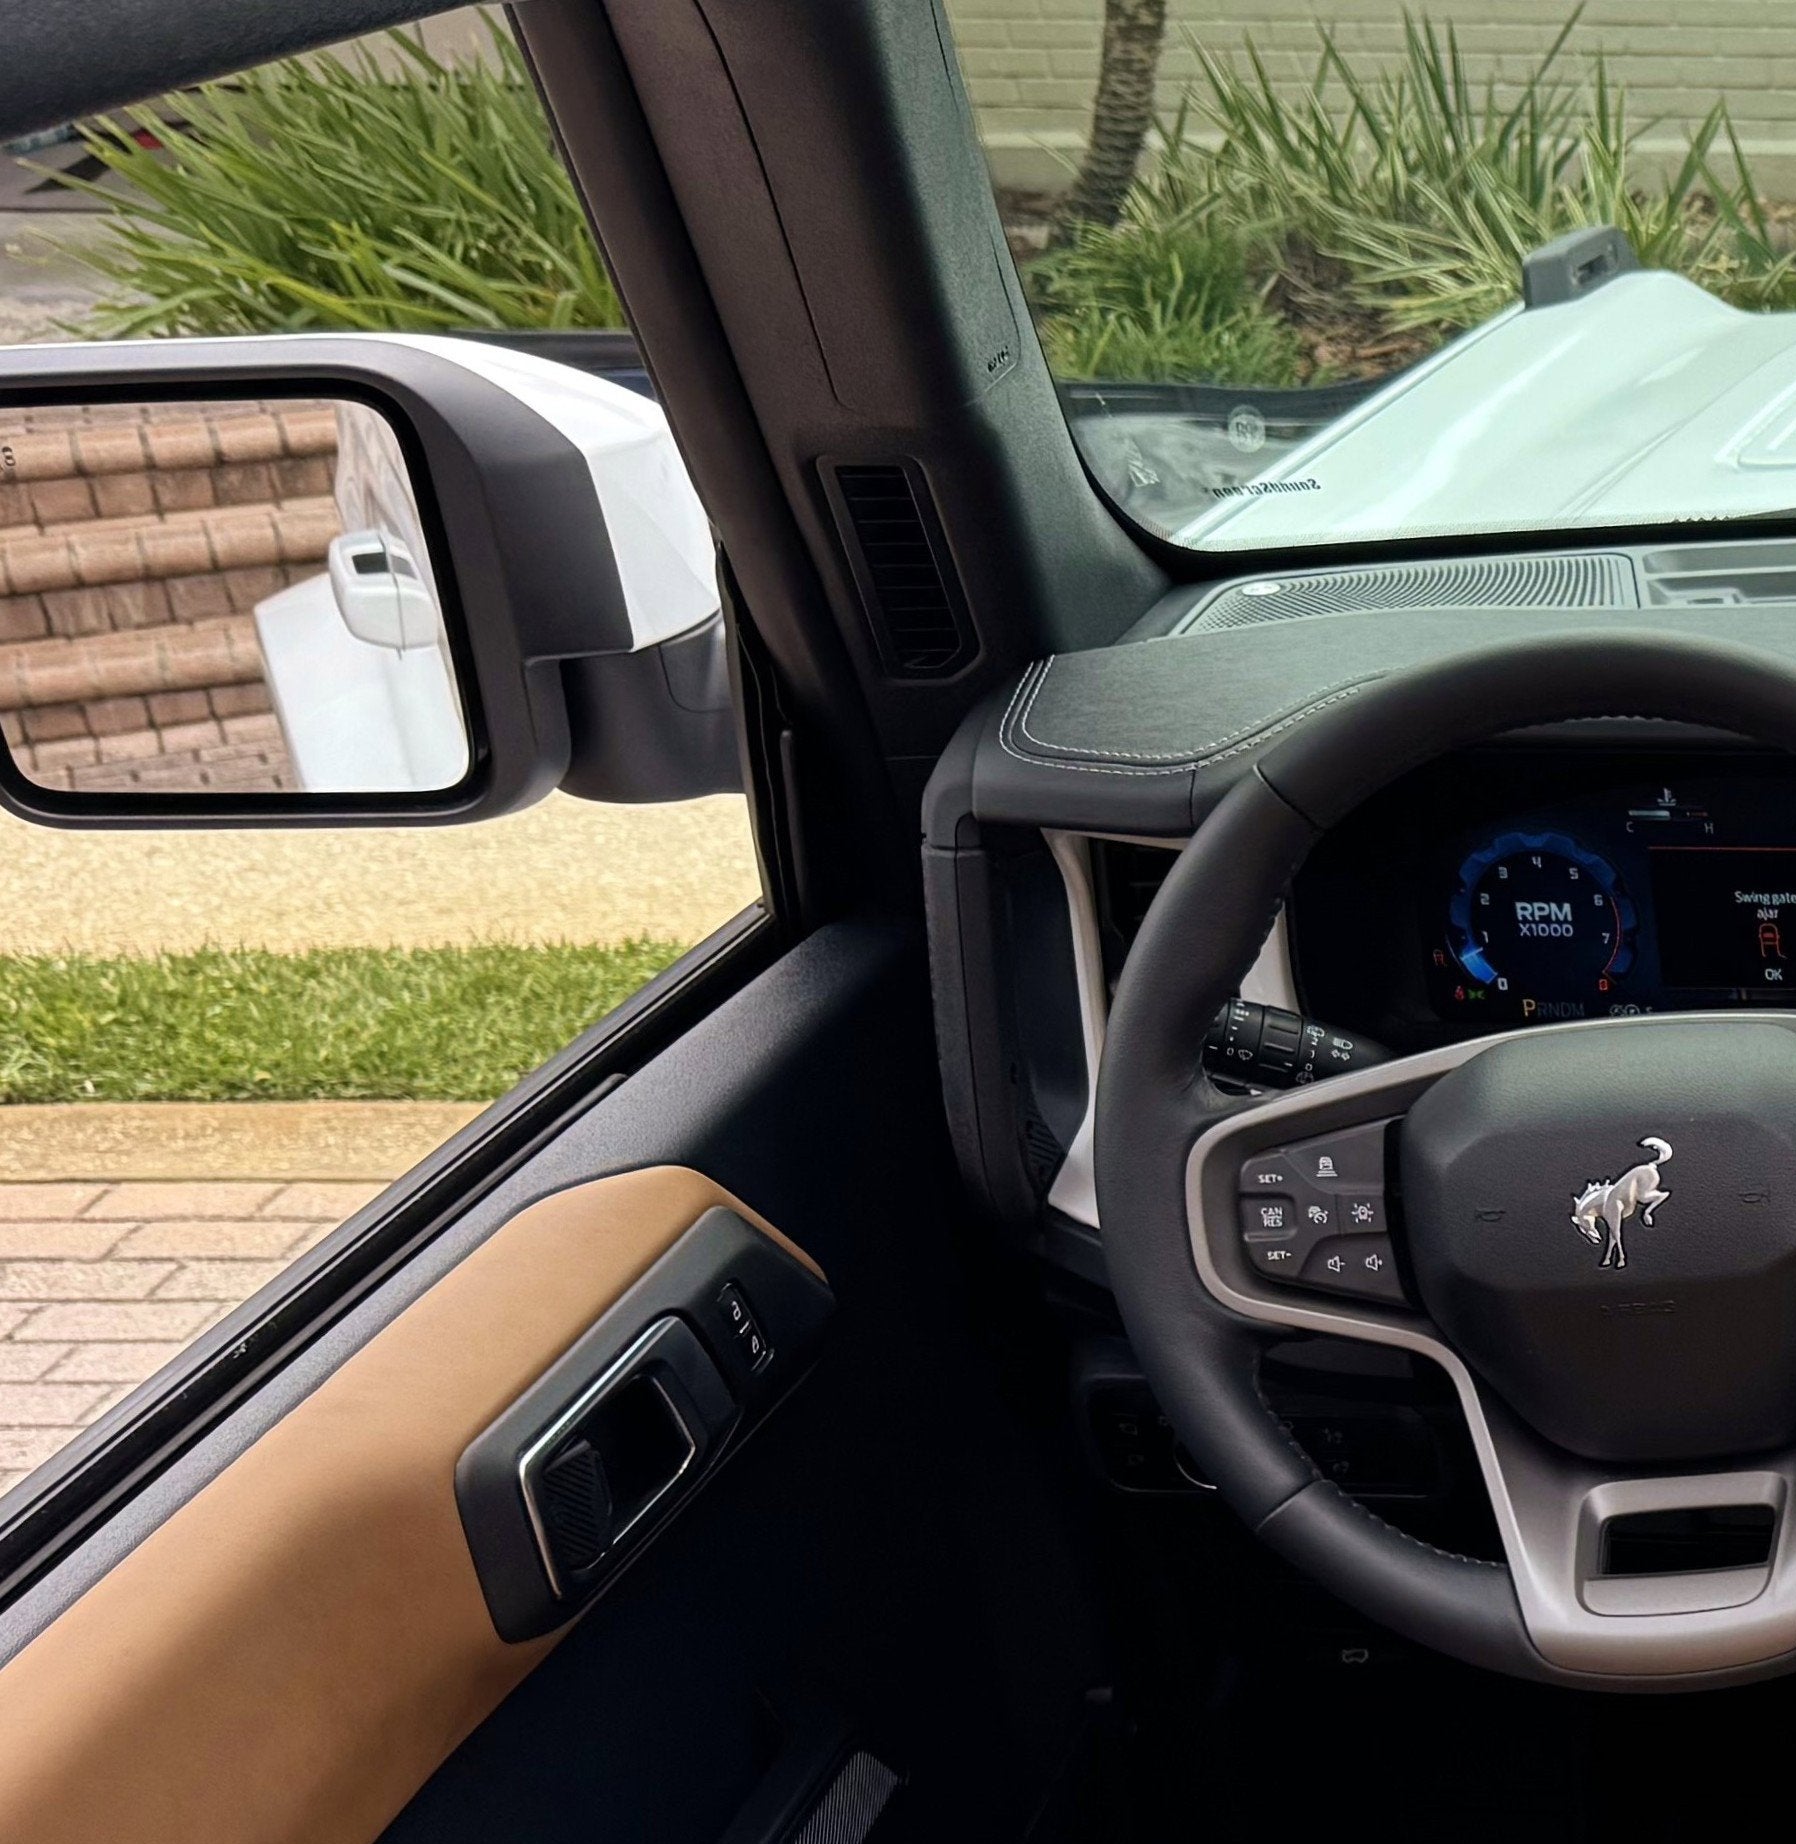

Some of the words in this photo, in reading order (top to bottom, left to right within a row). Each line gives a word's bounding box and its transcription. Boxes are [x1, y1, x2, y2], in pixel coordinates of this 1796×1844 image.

[1704, 822, 1714, 834] H
[1499, 867, 1508, 879] 3
[1569, 867, 1579, 880] 5
[1480, 893, 1490, 905] 2
[1734, 890, 1771, 906] Swing
[1515, 901, 1573, 922] RPM
[1757, 907, 1779, 921] ajar
[1519, 923, 1574, 937] X1000
[1602, 933, 1610, 944] 7
[1764, 968, 1783, 981] OK
[1260, 1207, 1283, 1217] CAN
